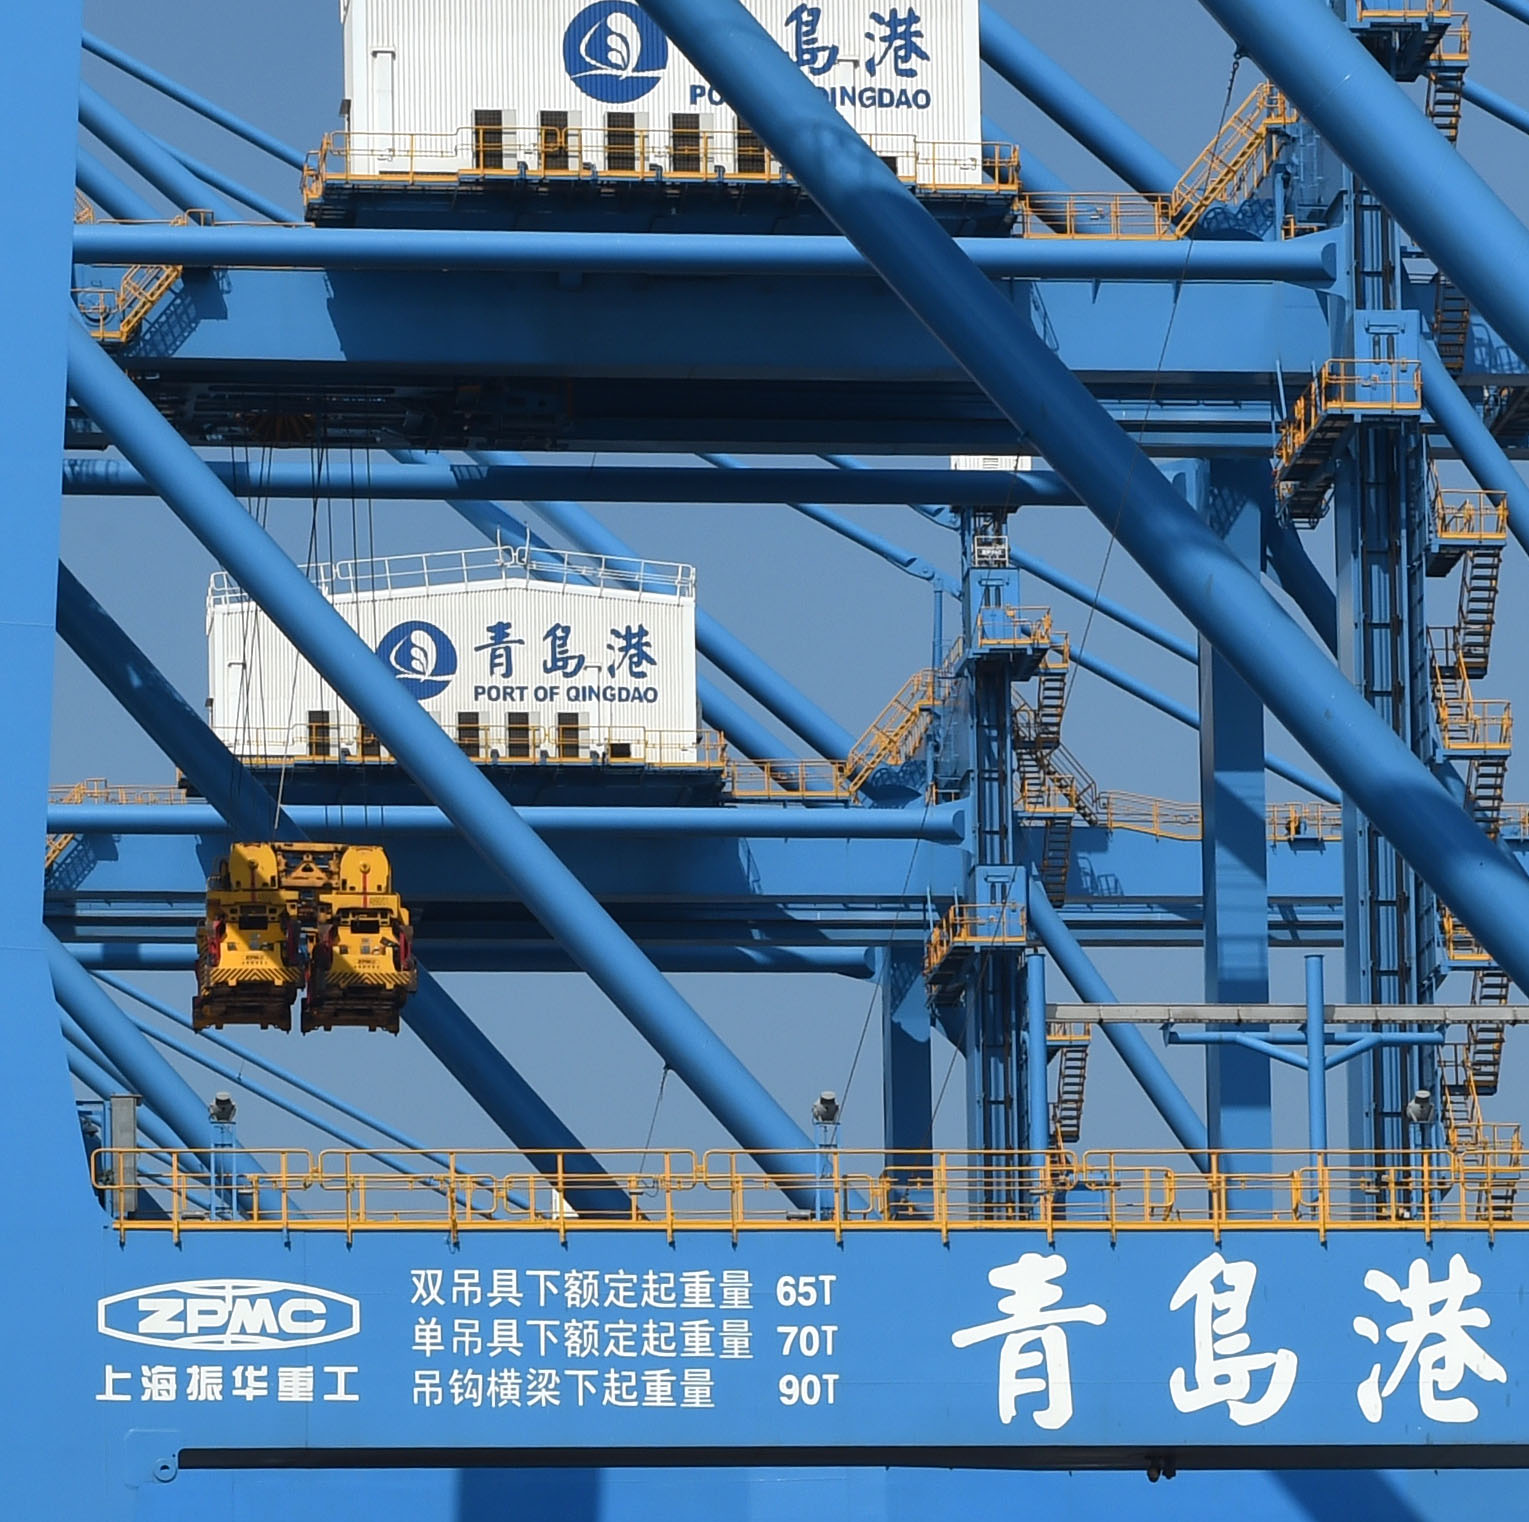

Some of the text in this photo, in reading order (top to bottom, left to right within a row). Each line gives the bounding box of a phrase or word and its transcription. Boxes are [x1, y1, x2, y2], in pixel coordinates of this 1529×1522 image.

[786, 2, 931, 78] 島港
[473, 621, 658, 680] 青島港
[474, 685, 659, 704] PORT OF QINGDAO
[410, 1268, 837, 1309] 双吊具下额定起重量 65T
[137, 1297, 328, 1335] ZPMC
[412, 1317, 839, 1359] 单吊具下额定起重量 70T
[951, 1252, 1508, 1430] 青島港
[95, 1364, 360, 1402] 上海振华重工
[412, 1367, 840, 1408] 吊钩横梁下起重量 90T
